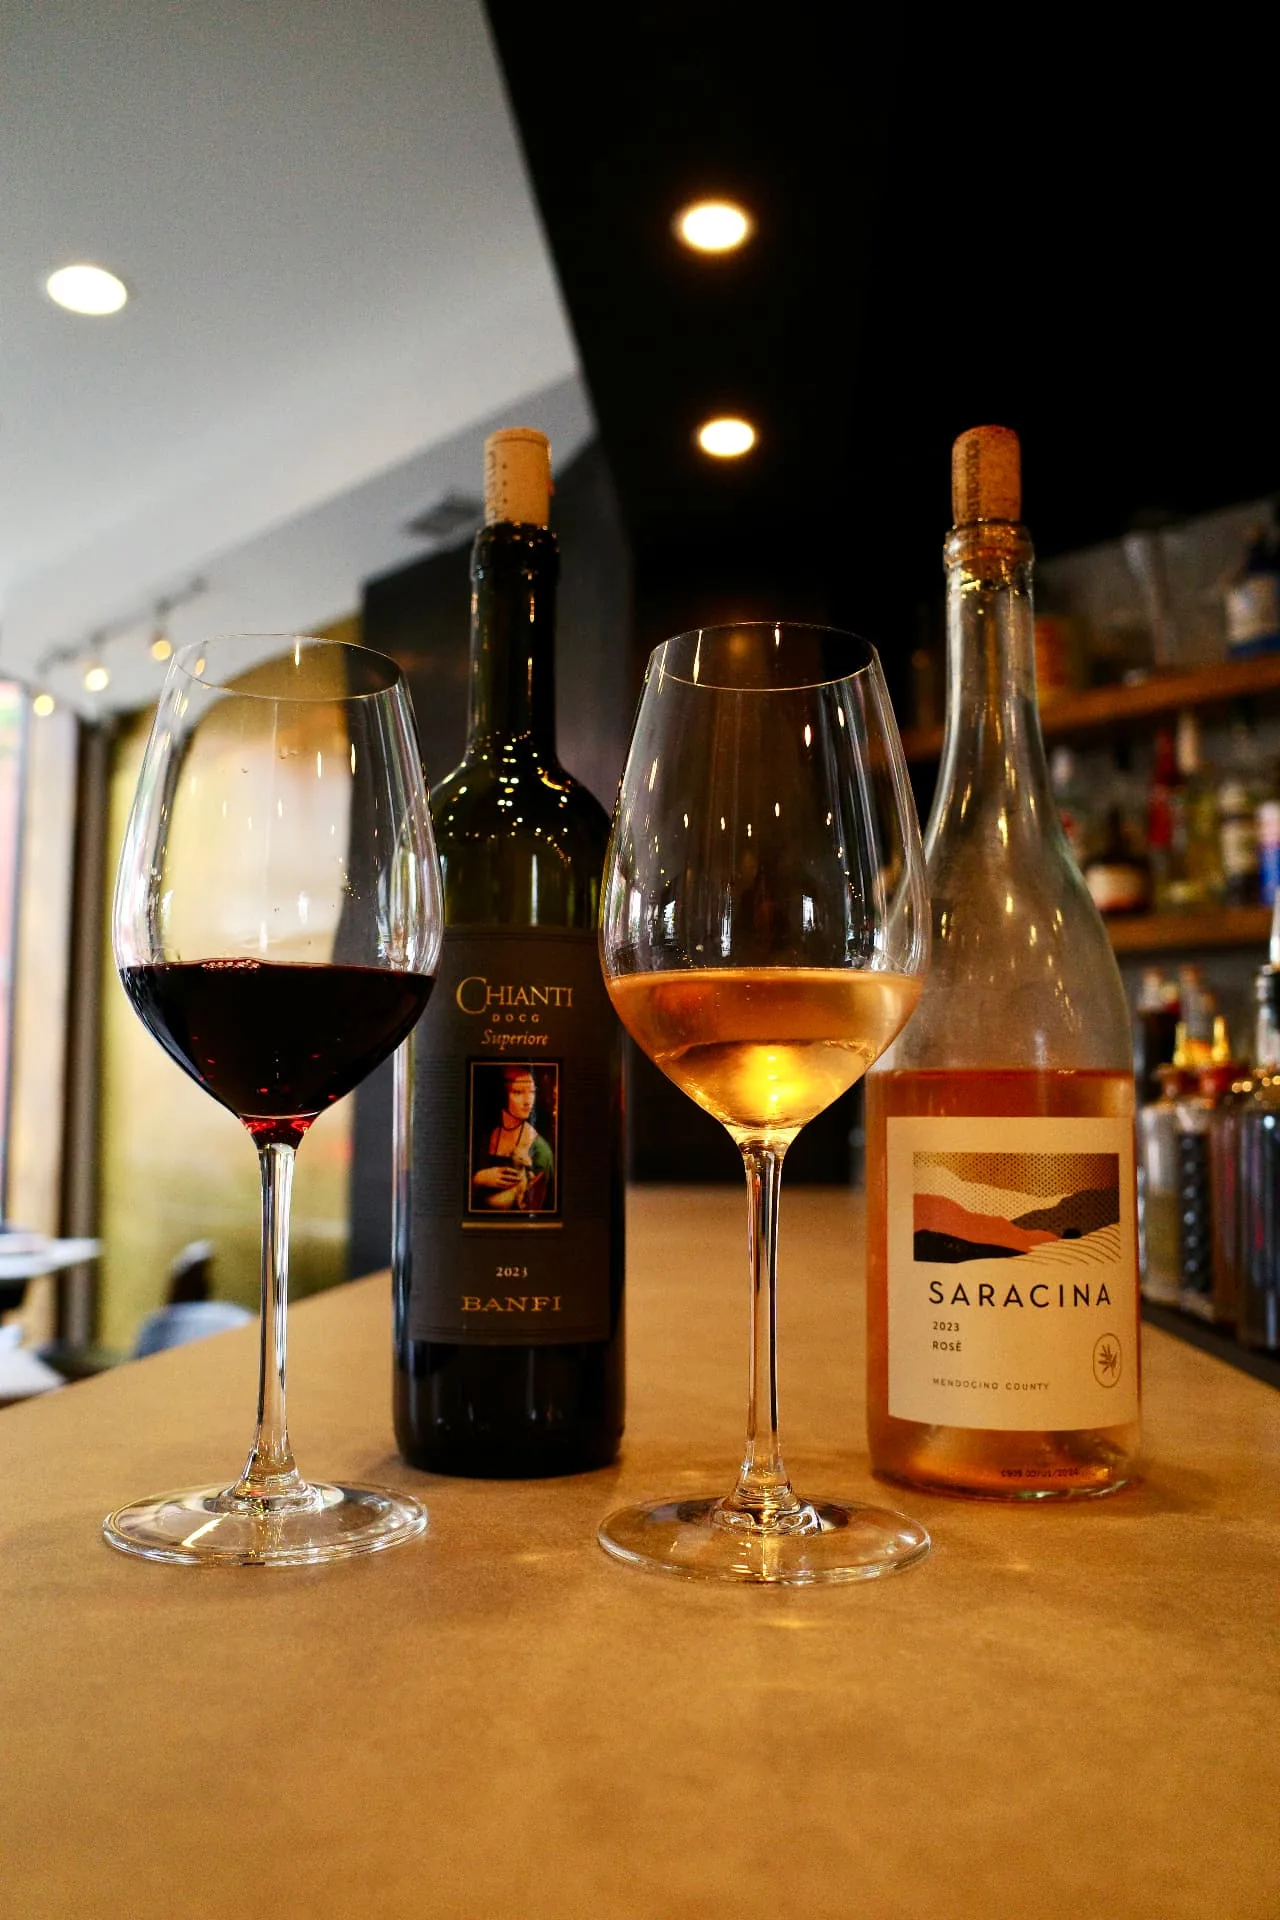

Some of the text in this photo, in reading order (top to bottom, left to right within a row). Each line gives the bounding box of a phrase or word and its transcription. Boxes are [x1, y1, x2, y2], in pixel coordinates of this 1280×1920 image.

[456, 976, 573, 1014] CHIANTI
[492, 1013, 541, 1023] DOCG
[481, 1029, 549, 1050] Superiore
[496, 1266, 528, 1278] 2023
[928, 1280, 1111, 1308] SARACINA
[461, 1295, 562, 1312] BANFI
[932, 1321, 960, 1332] 2023
[932, 1340, 962, 1352] ROSÉ
[932, 1378, 1050, 1391] MENDOCINO COUNTY
